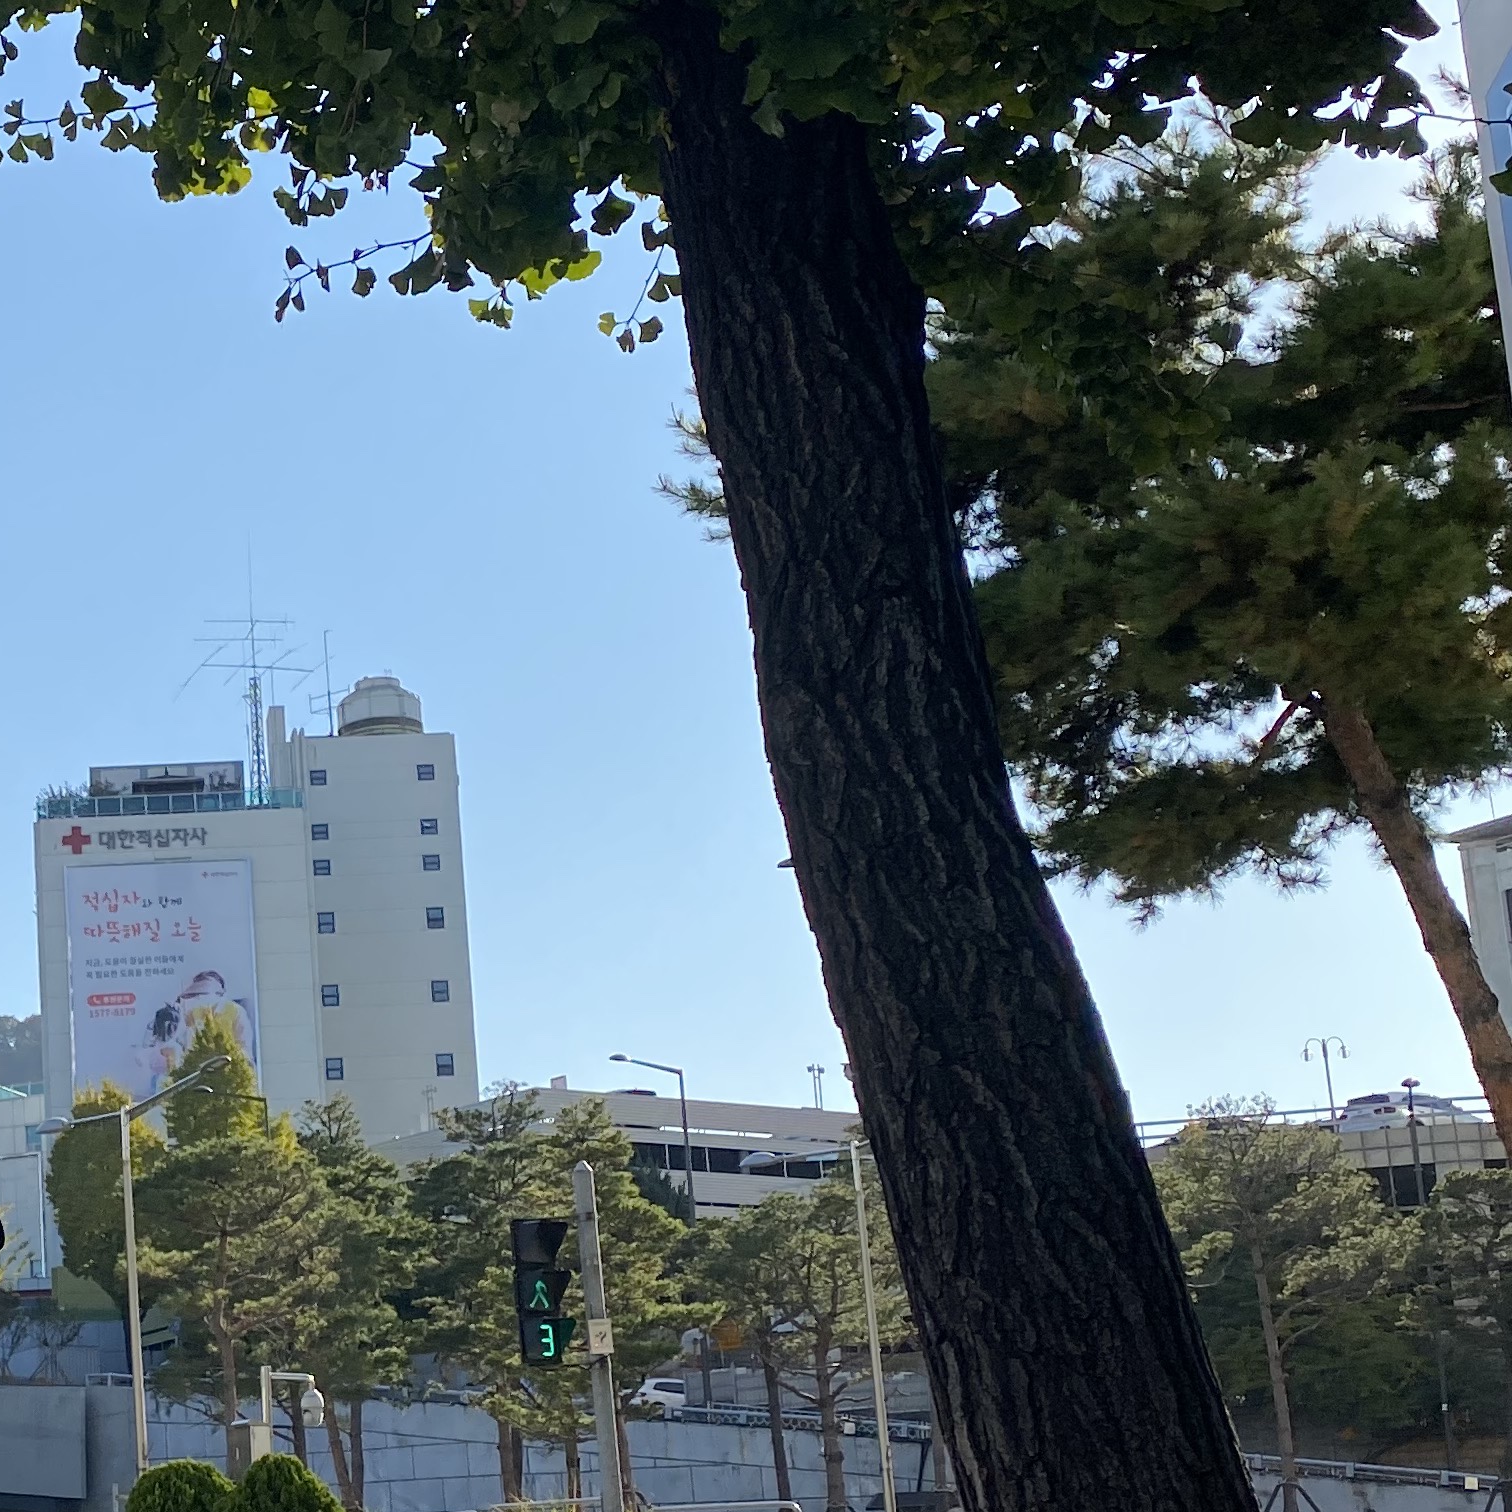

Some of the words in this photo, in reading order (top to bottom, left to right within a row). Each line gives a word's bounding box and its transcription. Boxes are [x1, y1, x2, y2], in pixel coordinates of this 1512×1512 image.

[98, 827, 208, 849] 대한적십자사
[83, 918, 160, 943] 따뜻해질
[171, 916, 202, 943] 오늘
[540, 1324, 554, 1357] 3
